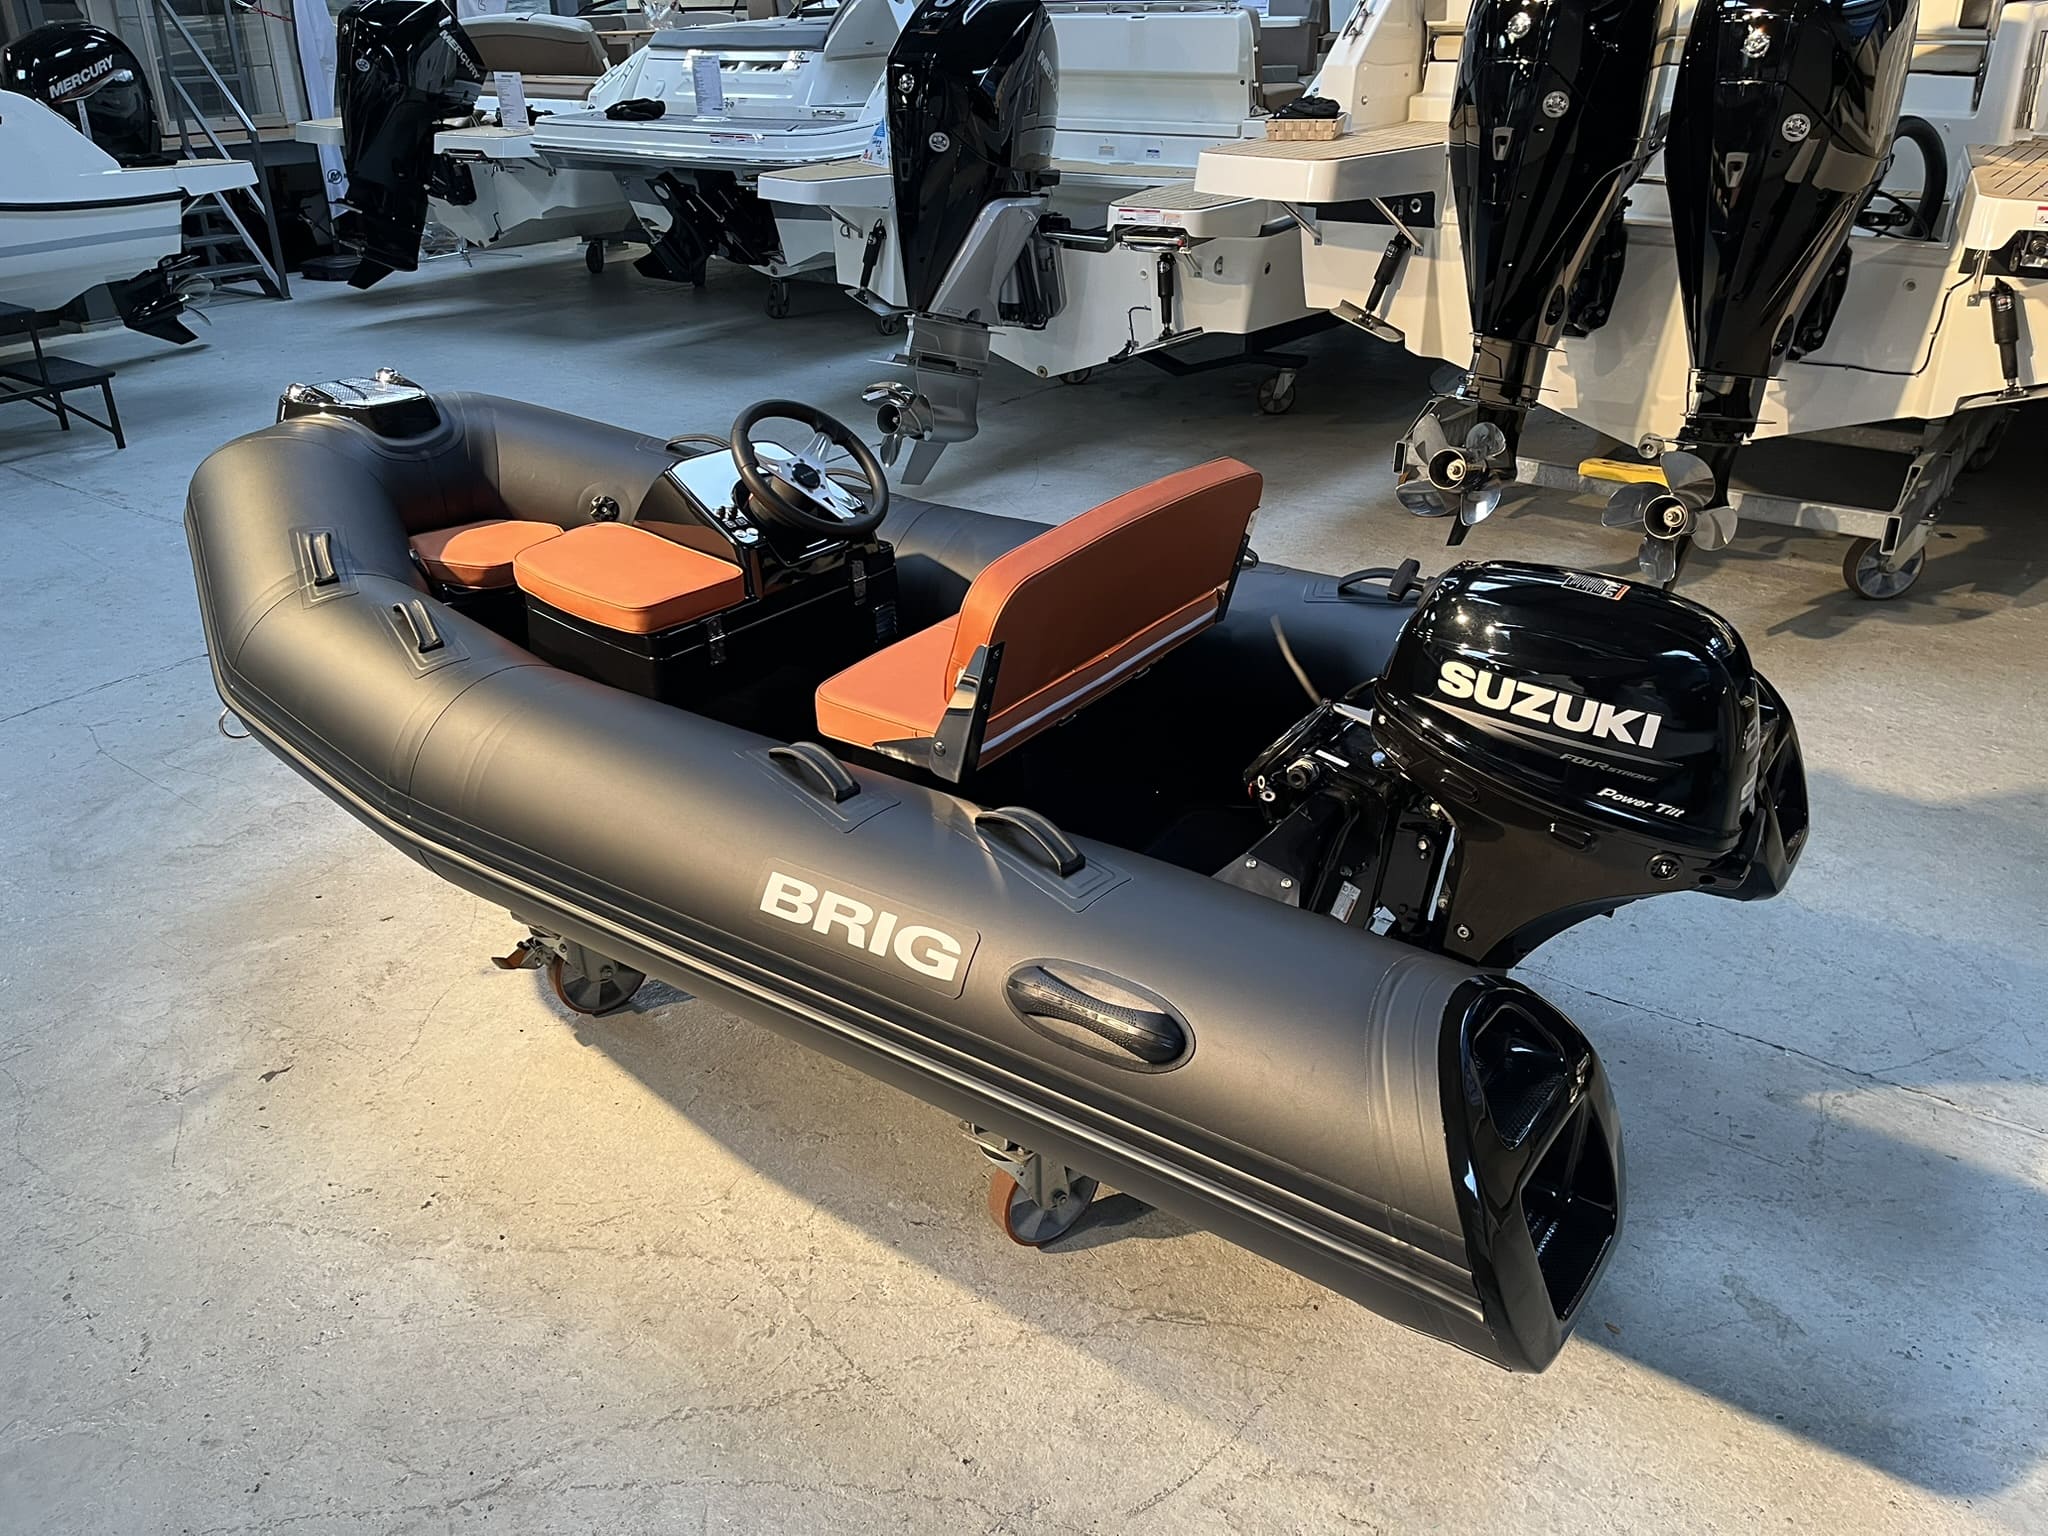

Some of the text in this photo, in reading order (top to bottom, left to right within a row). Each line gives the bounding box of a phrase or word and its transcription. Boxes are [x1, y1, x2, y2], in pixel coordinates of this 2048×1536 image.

[48, 54, 113, 99] MERCURY
[439, 29, 481, 80] MERCURY
[1437, 661, 1662, 749] SUZUKI
[1596, 787, 1685, 818] Power Tilt
[759, 871, 962, 982] BRIG
